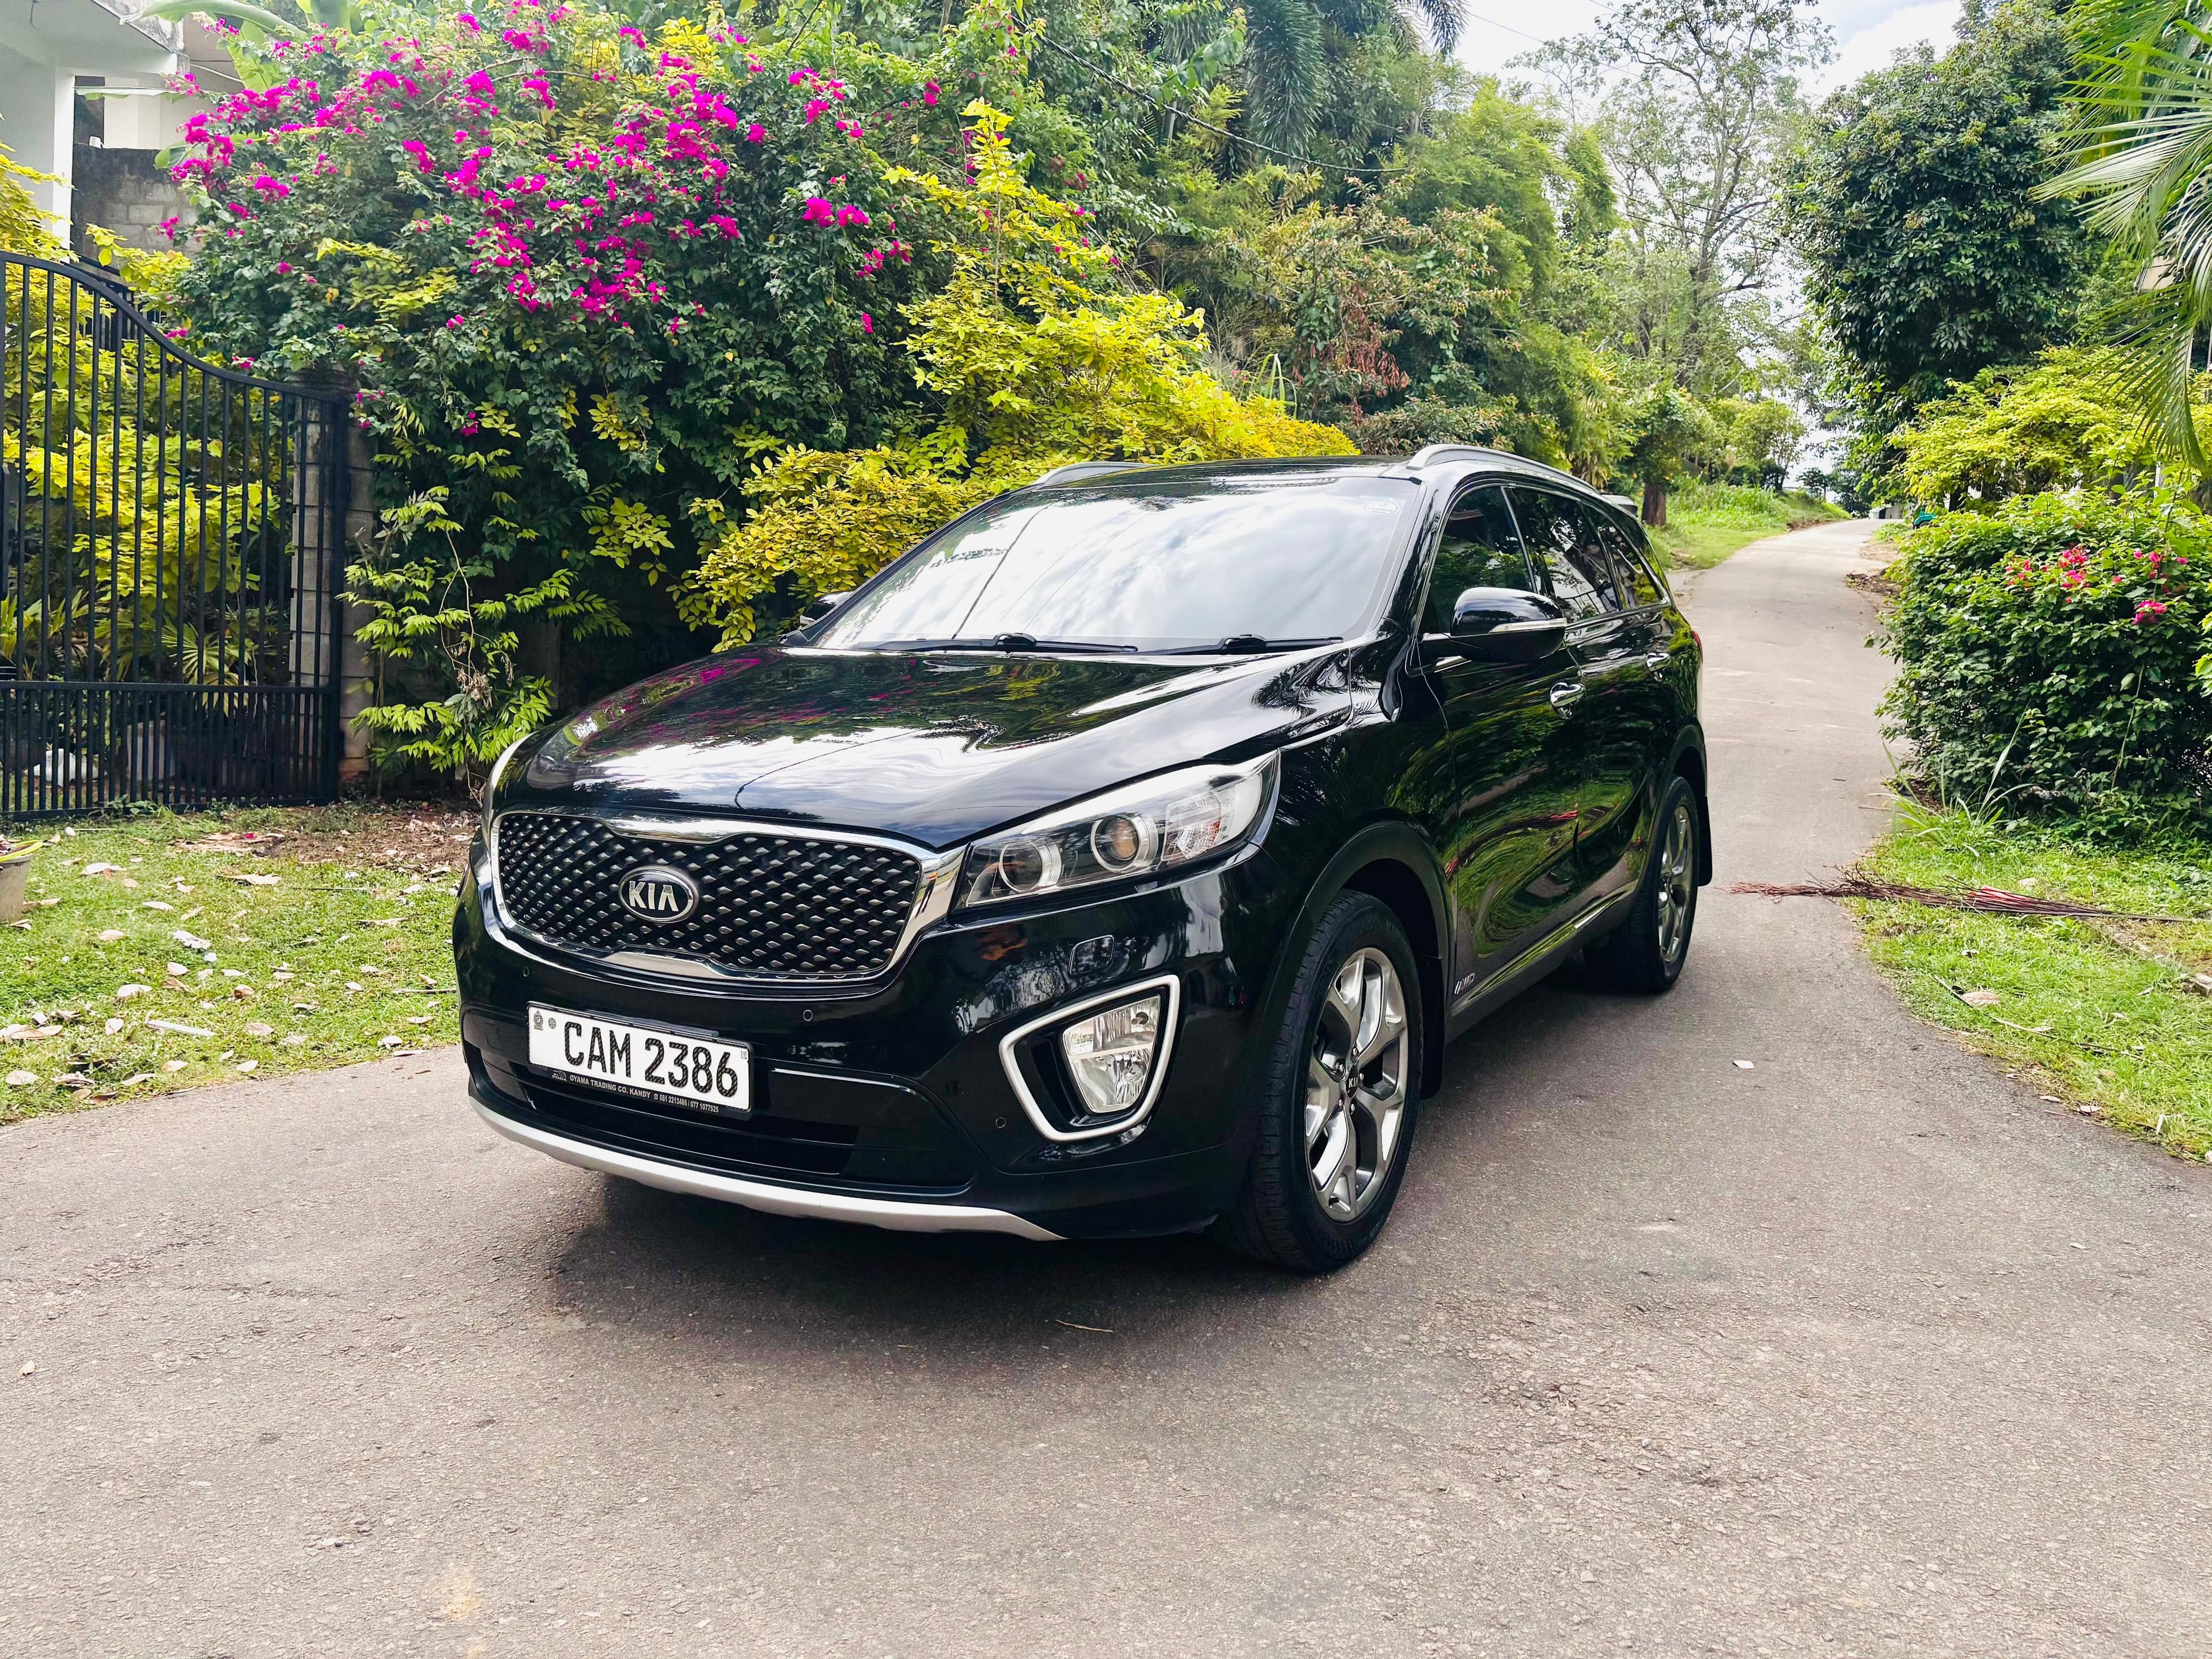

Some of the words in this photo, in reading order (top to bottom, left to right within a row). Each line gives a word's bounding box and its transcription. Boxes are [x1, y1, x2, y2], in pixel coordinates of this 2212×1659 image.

[629, 880, 679, 912] KIA
[565, 1021, 631, 1077] CAM
[645, 1038, 737, 1097] 2386
[570, 1075, 589, 1085] OYAMA
[590, 1080, 616, 1090] TRADING
[630, 1088, 650, 1098] KANDY
